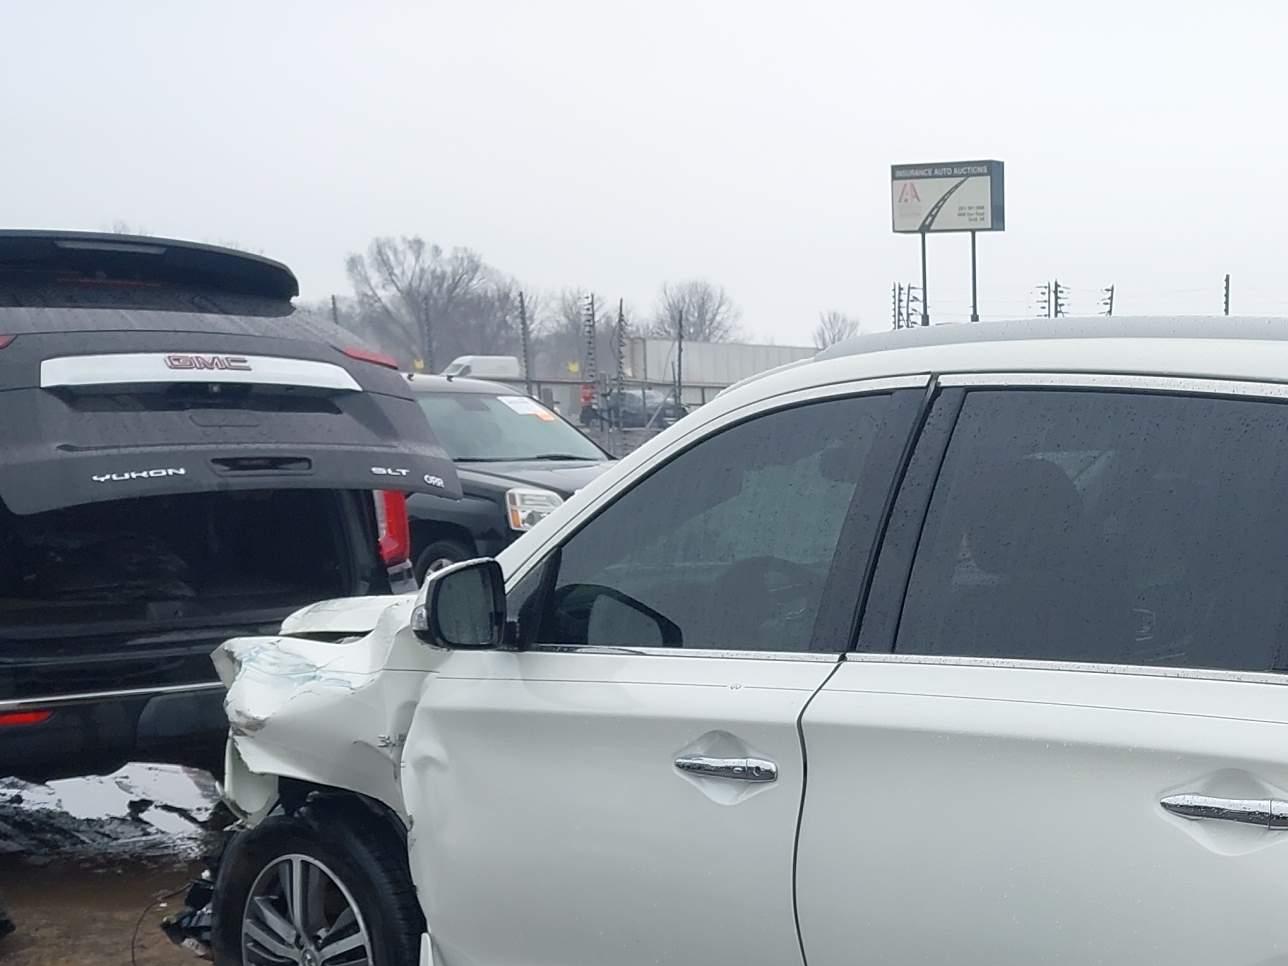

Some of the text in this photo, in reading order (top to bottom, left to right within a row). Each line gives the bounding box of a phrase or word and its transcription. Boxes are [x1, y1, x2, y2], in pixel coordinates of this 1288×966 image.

[165, 355, 252, 371] GMC
[92, 467, 186, 482] YUKON
[371, 466, 410, 476] SLT
